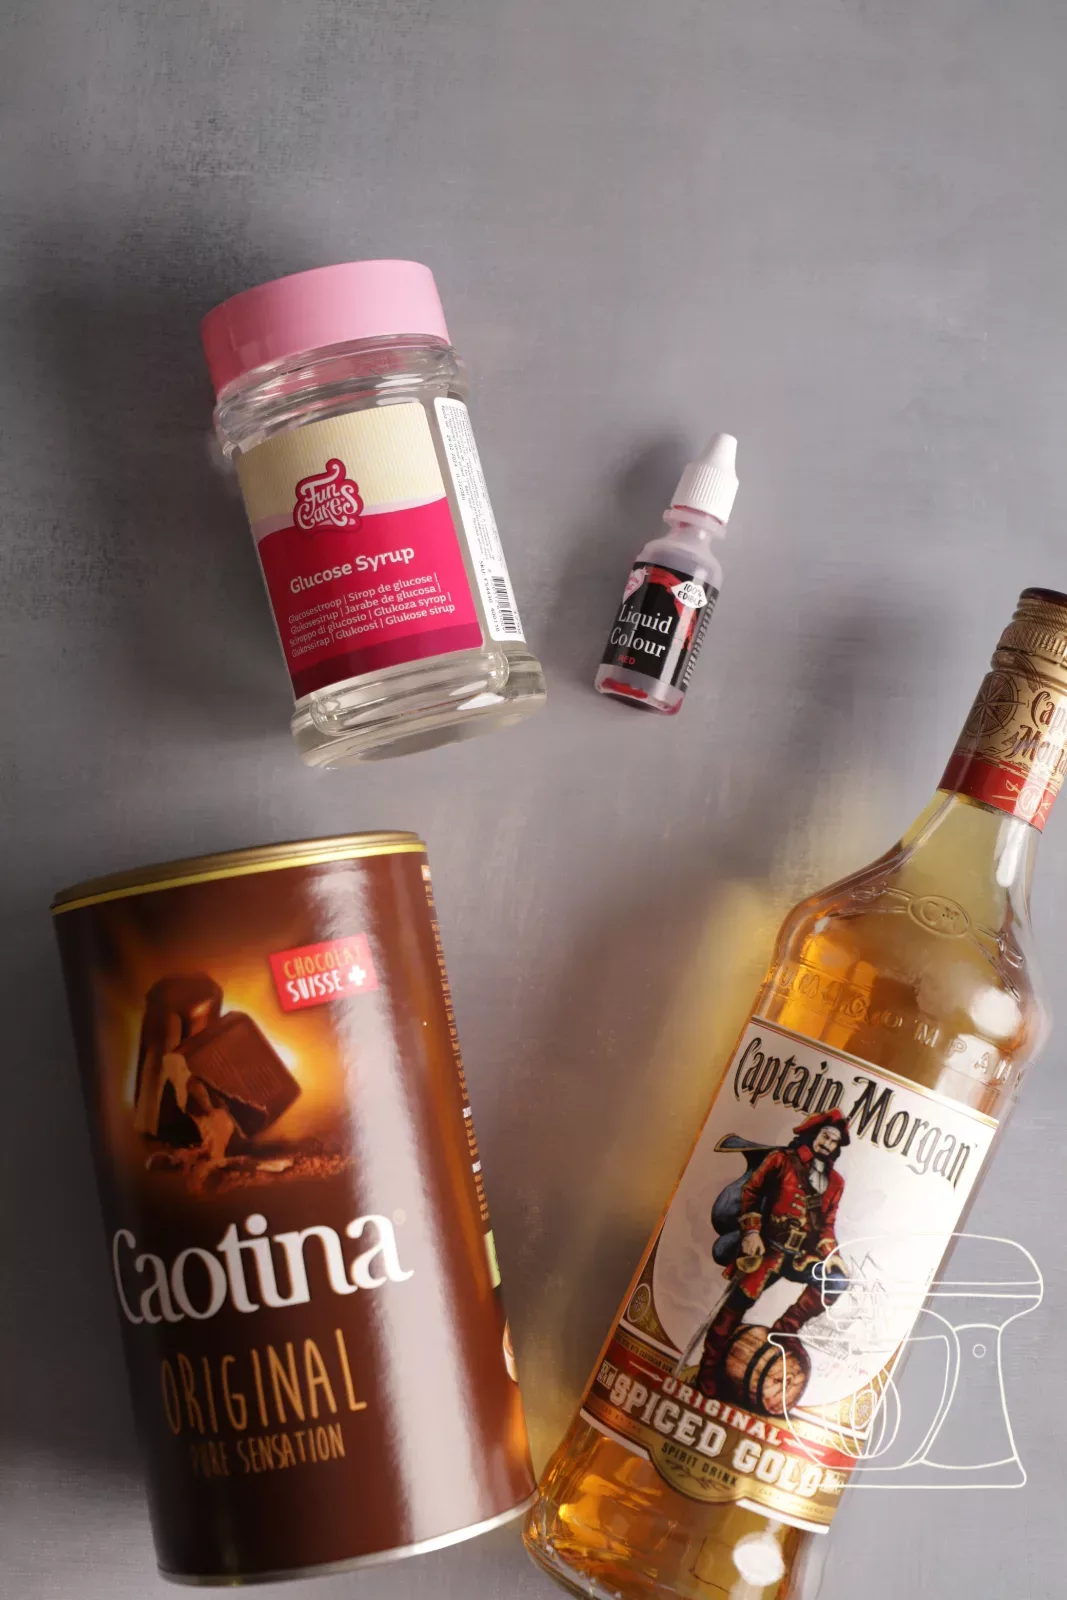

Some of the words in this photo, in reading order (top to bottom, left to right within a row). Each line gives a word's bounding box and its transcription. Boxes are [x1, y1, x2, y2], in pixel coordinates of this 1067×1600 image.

[300, 464, 341, 520] Fun
[290, 563, 352, 594] Glucose
[355, 547, 415, 572] Syrup
[683, 583, 702, 598] 100%
[288, 598, 342, 624] Glucosestroop
[349, 588, 376, 602] Sirop
[377, 583, 391, 593] de
[393, 574, 433, 591] glucose
[289, 630, 317, 647] Sciroppo
[318, 626, 326, 635] di
[328, 614, 367, 634] glucosio
[373, 601, 417, 618] Glukoza
[418, 594, 447, 608] syrop
[291, 611, 339, 635] Glukosesirup
[346, 599, 379, 615] Jarabe
[381, 594, 394, 604] de
[396, 585, 436, 603] glucosa
[336, 622, 379, 640] Glukoosi
[385, 610, 428, 625] Glukose
[429, 604, 456, 616] sirup
[618, 604, 673, 634] Liquid
[677, 590, 703, 607] EDIBLE
[610, 627, 666, 658] Colour
[286, 969, 343, 1003] SUISSE
[733, 1036, 845, 1115] Captain
[846, 1075, 971, 1190] Morgan
[112, 1213, 415, 1324] Caotina
[161, 1328, 367, 1435] ORIGINAL
[609, 1372, 727, 1458] SPICED
[732, 1440, 821, 1498] GOLD
[662, 1376, 783, 1447] ORIGINAL
[237, 1422, 346, 1474] SENSATION
[661, 1442, 698, 1468] SPIRIT
[701, 1462, 738, 1488] DRINK
